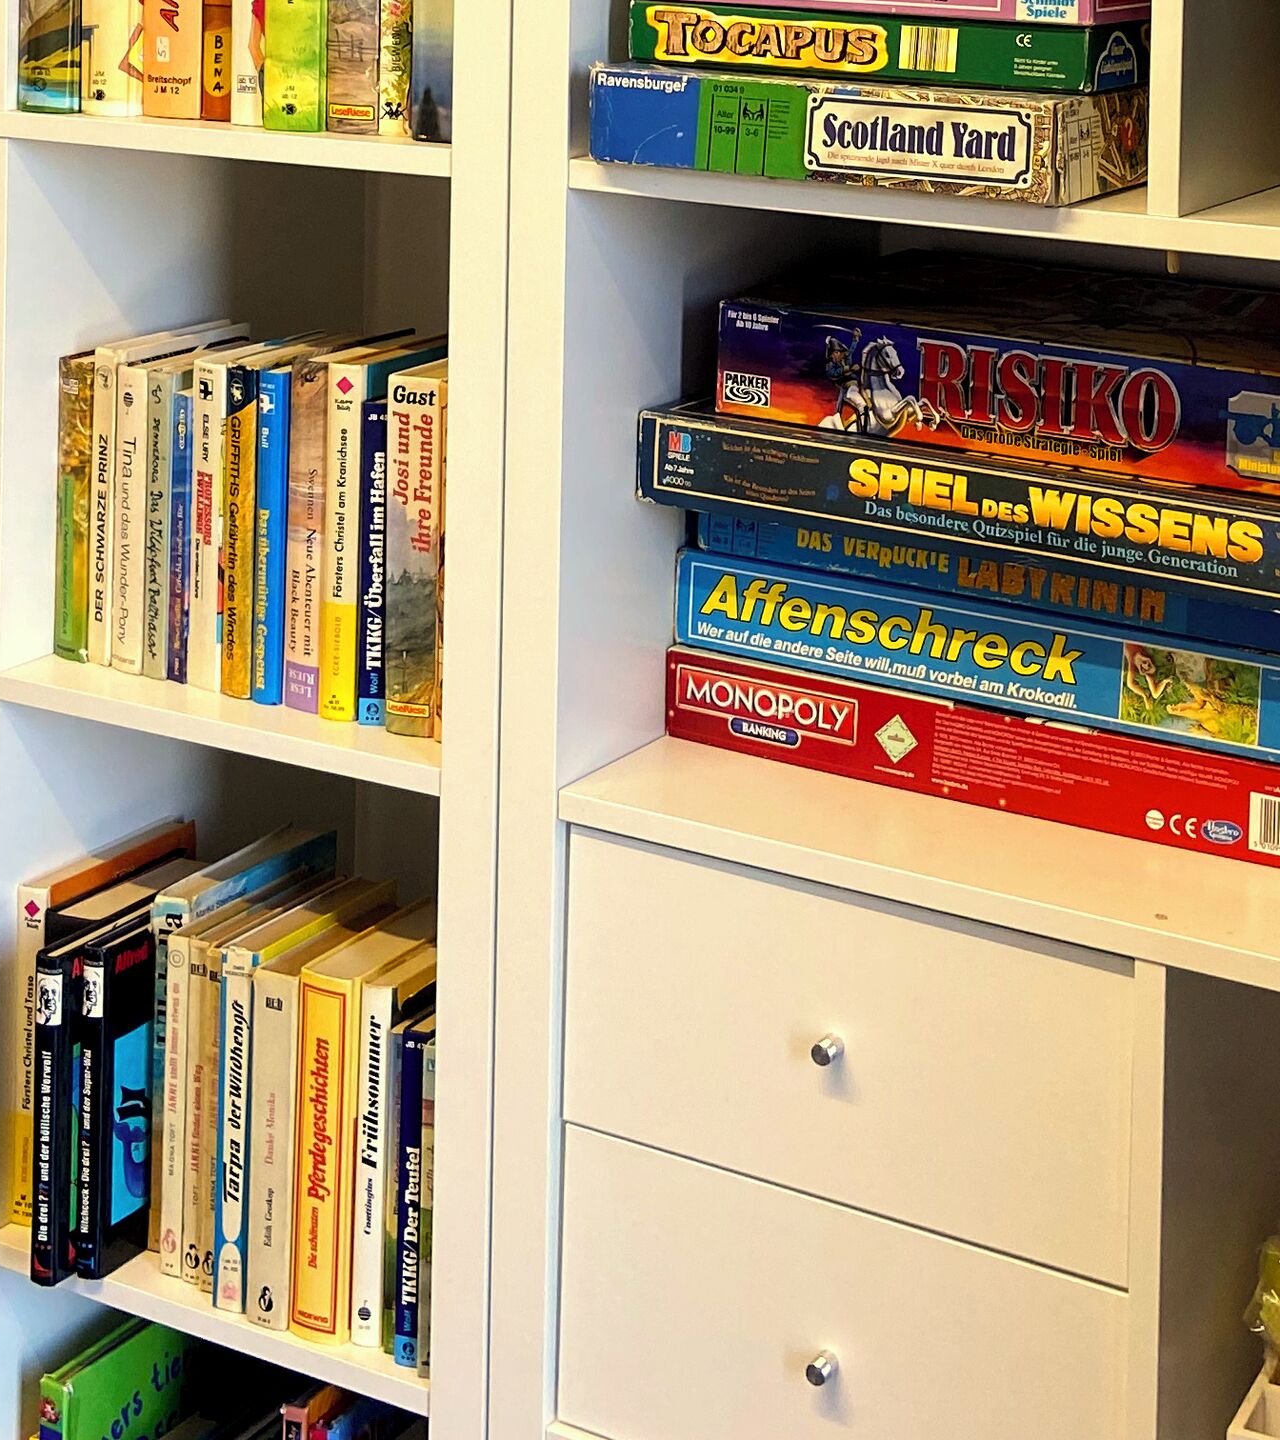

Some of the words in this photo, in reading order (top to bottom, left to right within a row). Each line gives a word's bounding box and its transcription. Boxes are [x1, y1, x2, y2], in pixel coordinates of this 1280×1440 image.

[1026, 4, 1067, 20] Spiele
[653, 12, 879, 64] TOCAPUS
[597, 73, 688, 93] Ravensburger
[822, 114, 944, 156] Scotland
[951, 122, 1016, 162] Yard
[393, 385, 436, 407] Gast
[724, 373, 769, 391] PARKER
[917, 337, 1181, 453] RISIKO
[229, 416, 241, 497] GRIFFITHS
[392, 412, 411, 454] und
[97, 434, 109, 485] PRINZ
[367, 451, 385, 504] Hafen
[392, 459, 411, 505] Josi
[414, 414, 434, 504] Freunde
[95, 488, 106, 583] SCHWARZE
[368, 506, 383, 527] im
[411, 508, 432, 554] ihre
[848, 458, 978, 516] SPIEL
[983, 498, 1030, 523] DES
[1029, 485, 1264, 564] WISSENS
[94, 586, 104, 623] DER
[700, 573, 1085, 686] Affenschreck
[686, 676, 850, 732] MONOPOLY
[742, 721, 787, 742] BANKING
[361, 1015, 382, 1169] Frühsommer
[306, 1037, 331, 1202] Pferdegeschichten
[405, 1146, 421, 1198] Teufel
